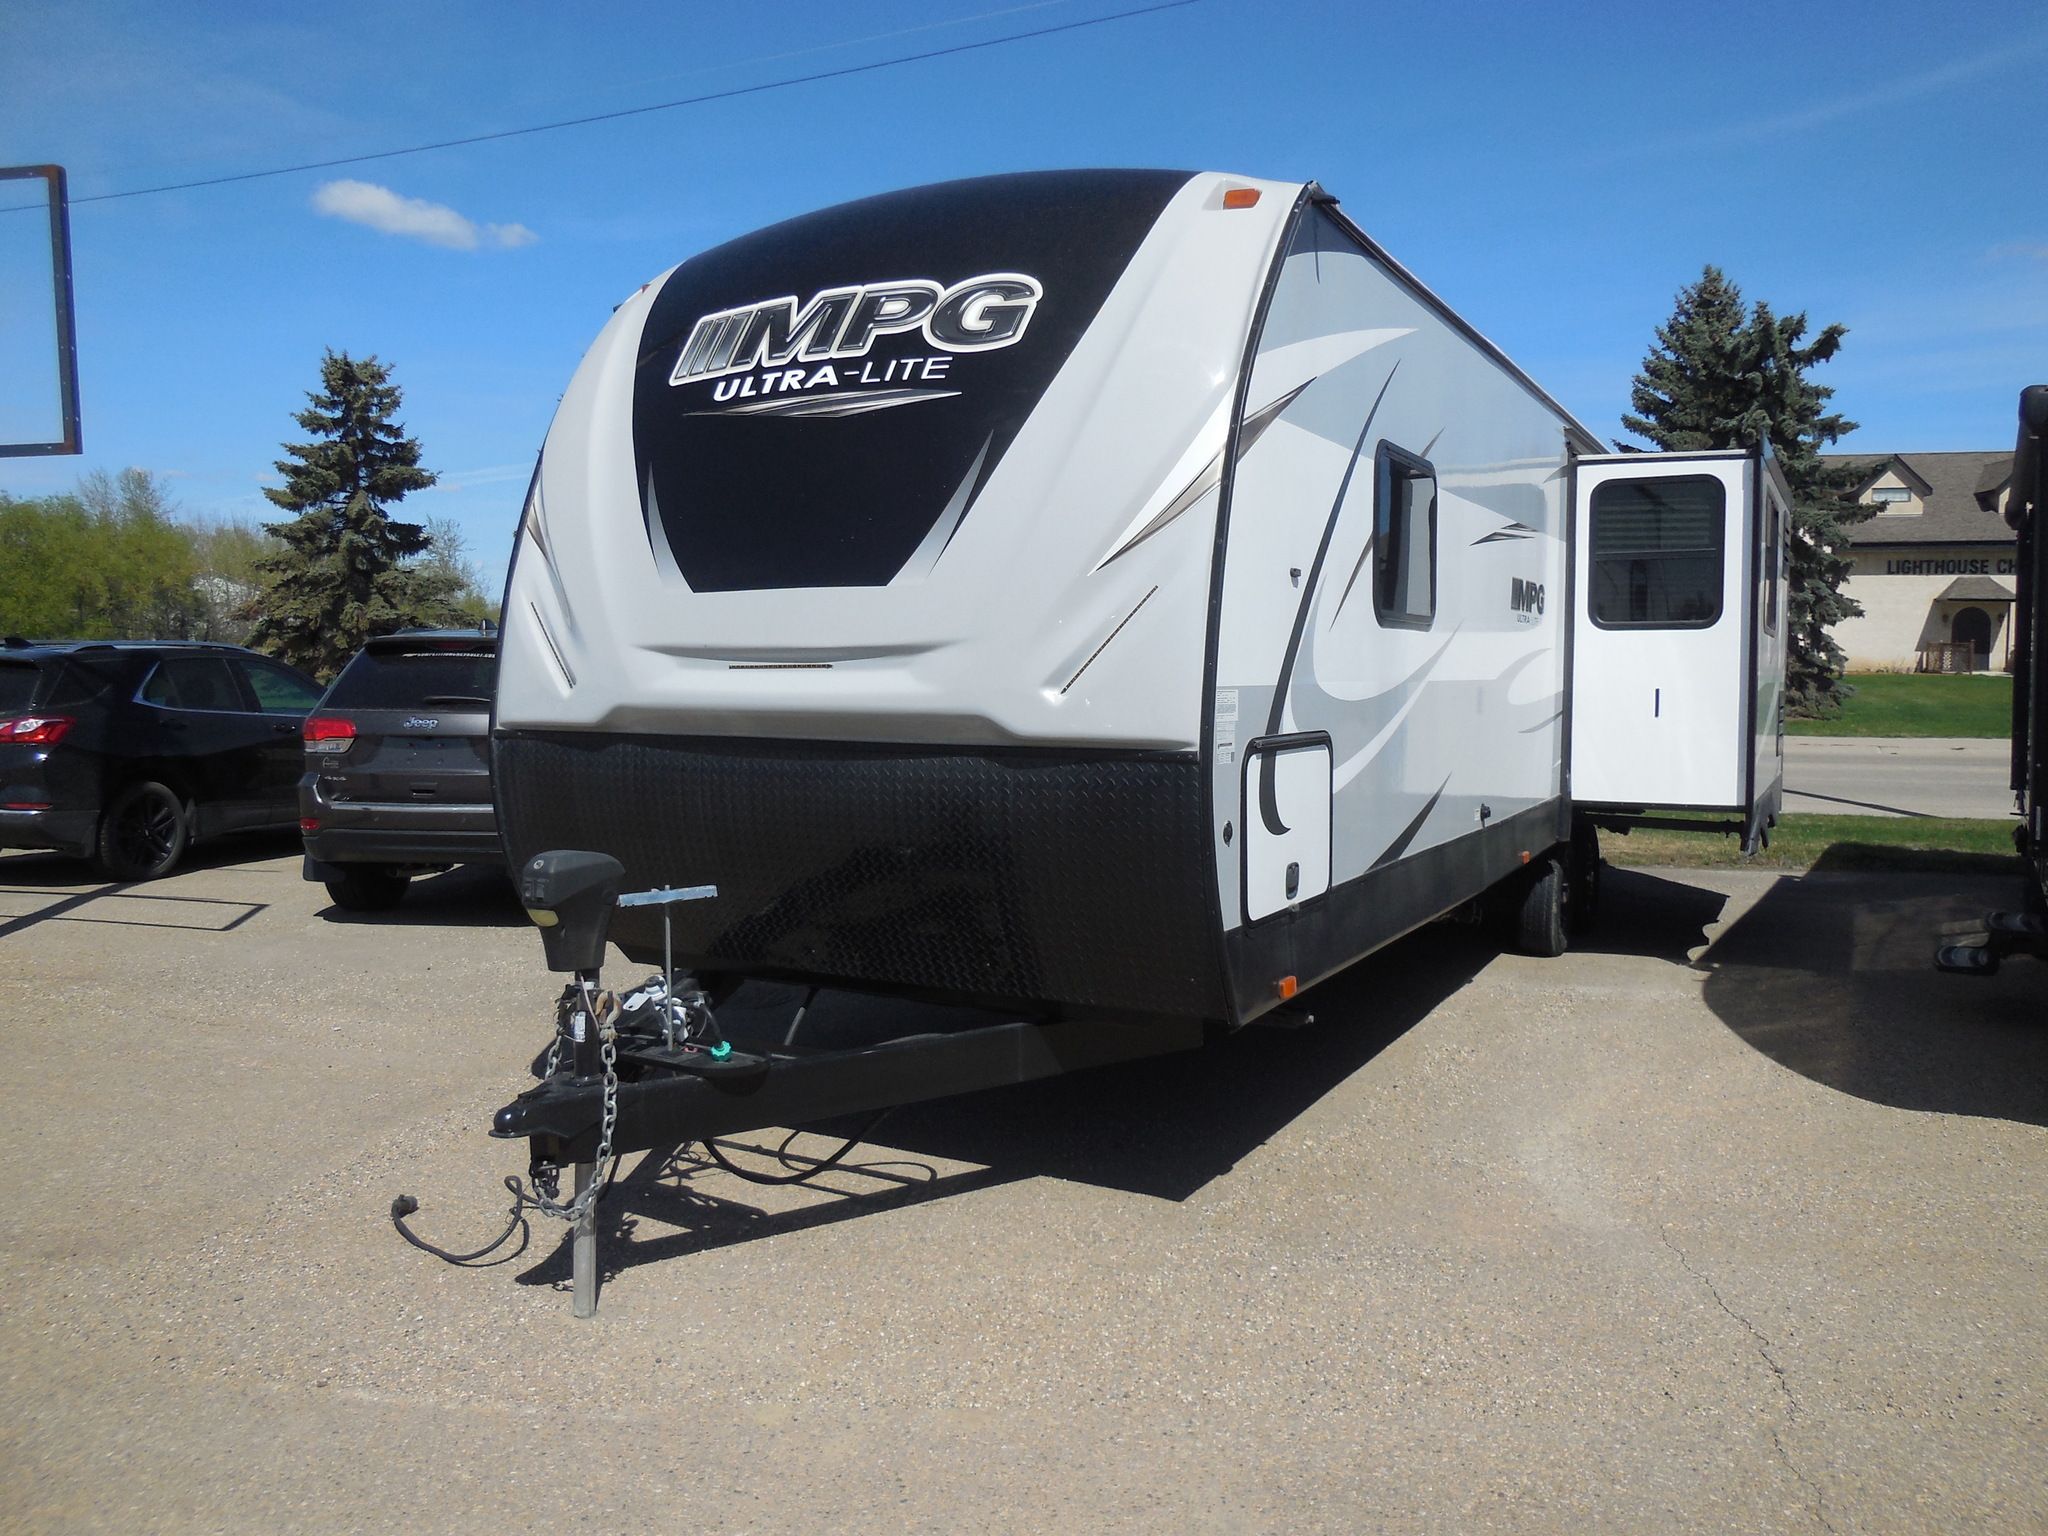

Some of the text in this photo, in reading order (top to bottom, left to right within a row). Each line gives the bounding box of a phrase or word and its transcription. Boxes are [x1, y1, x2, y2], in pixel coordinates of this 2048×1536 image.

[714, 356, 953, 402] ULTRA-LITE
[1887, 559, 1989, 575] LIGHTHOUSE
[404, 716, 439, 729] Jeep
